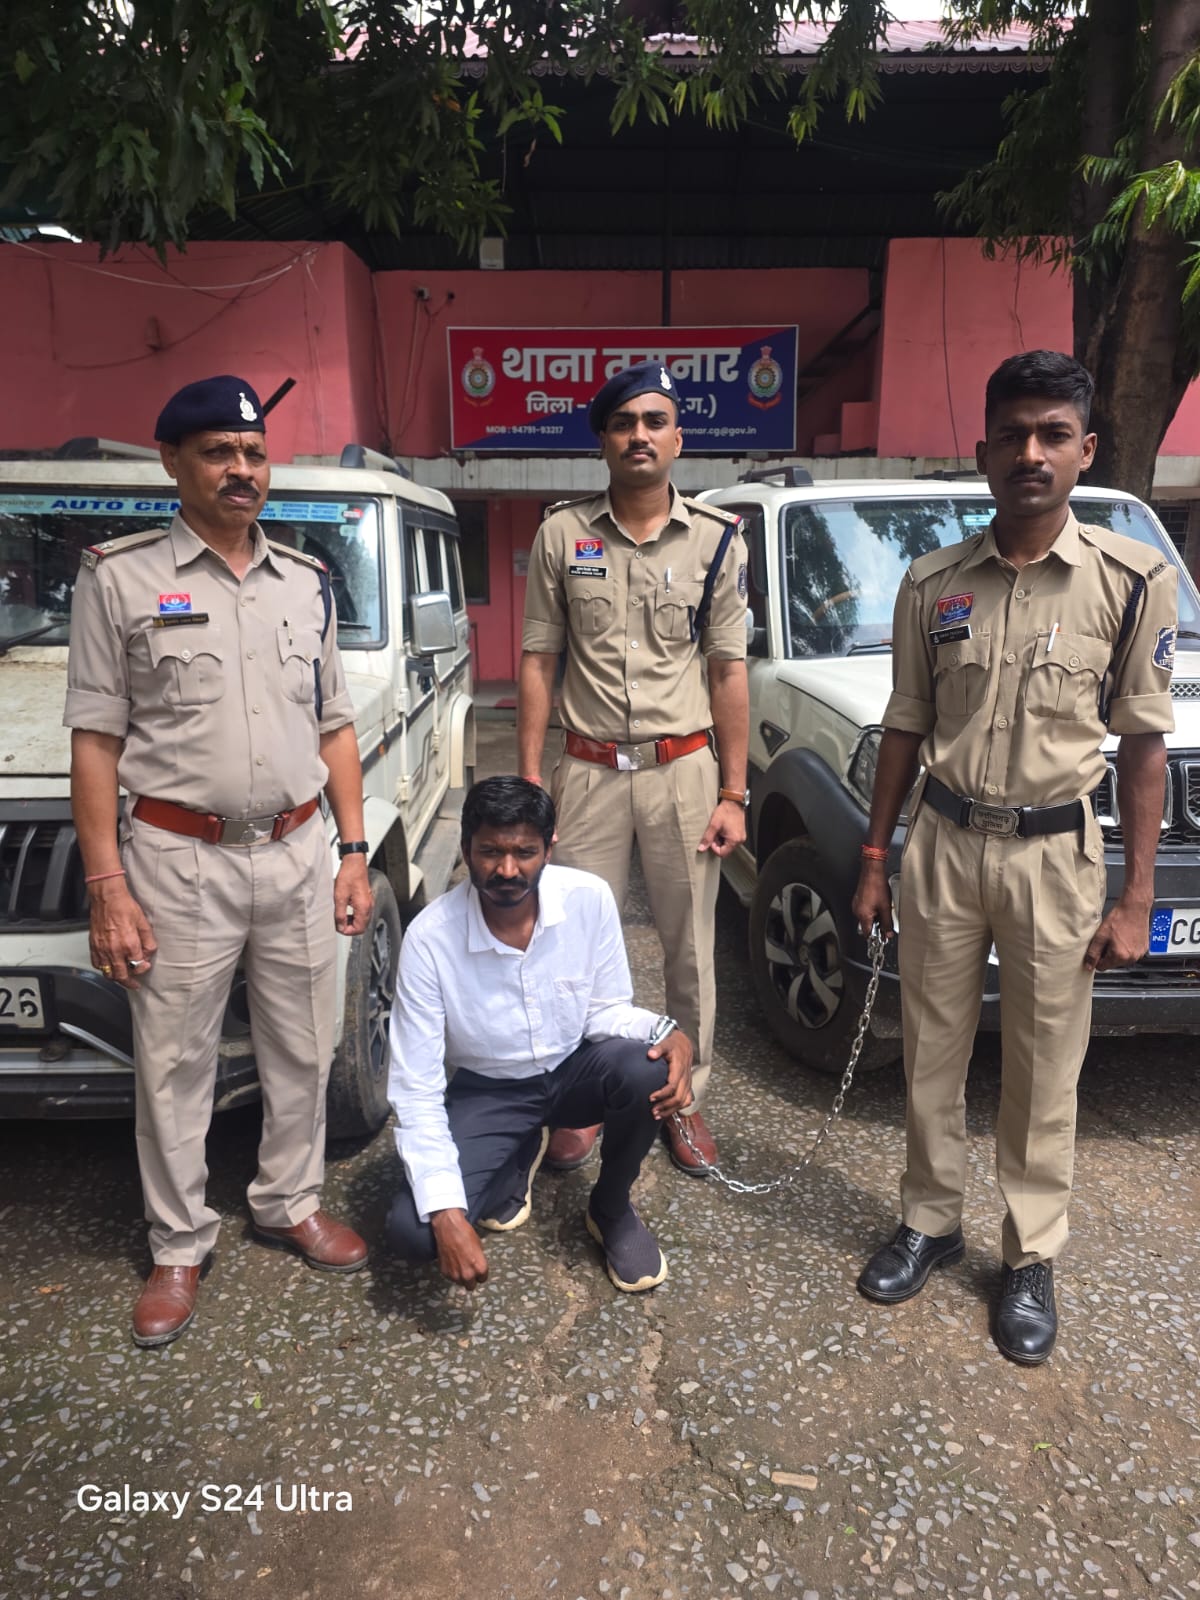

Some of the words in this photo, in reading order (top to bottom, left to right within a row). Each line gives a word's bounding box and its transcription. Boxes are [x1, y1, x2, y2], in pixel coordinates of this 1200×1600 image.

[502, 347, 597, 383] थाना
[525, 390, 574, 414] जिला
[51, 499, 125, 511] AUTO
